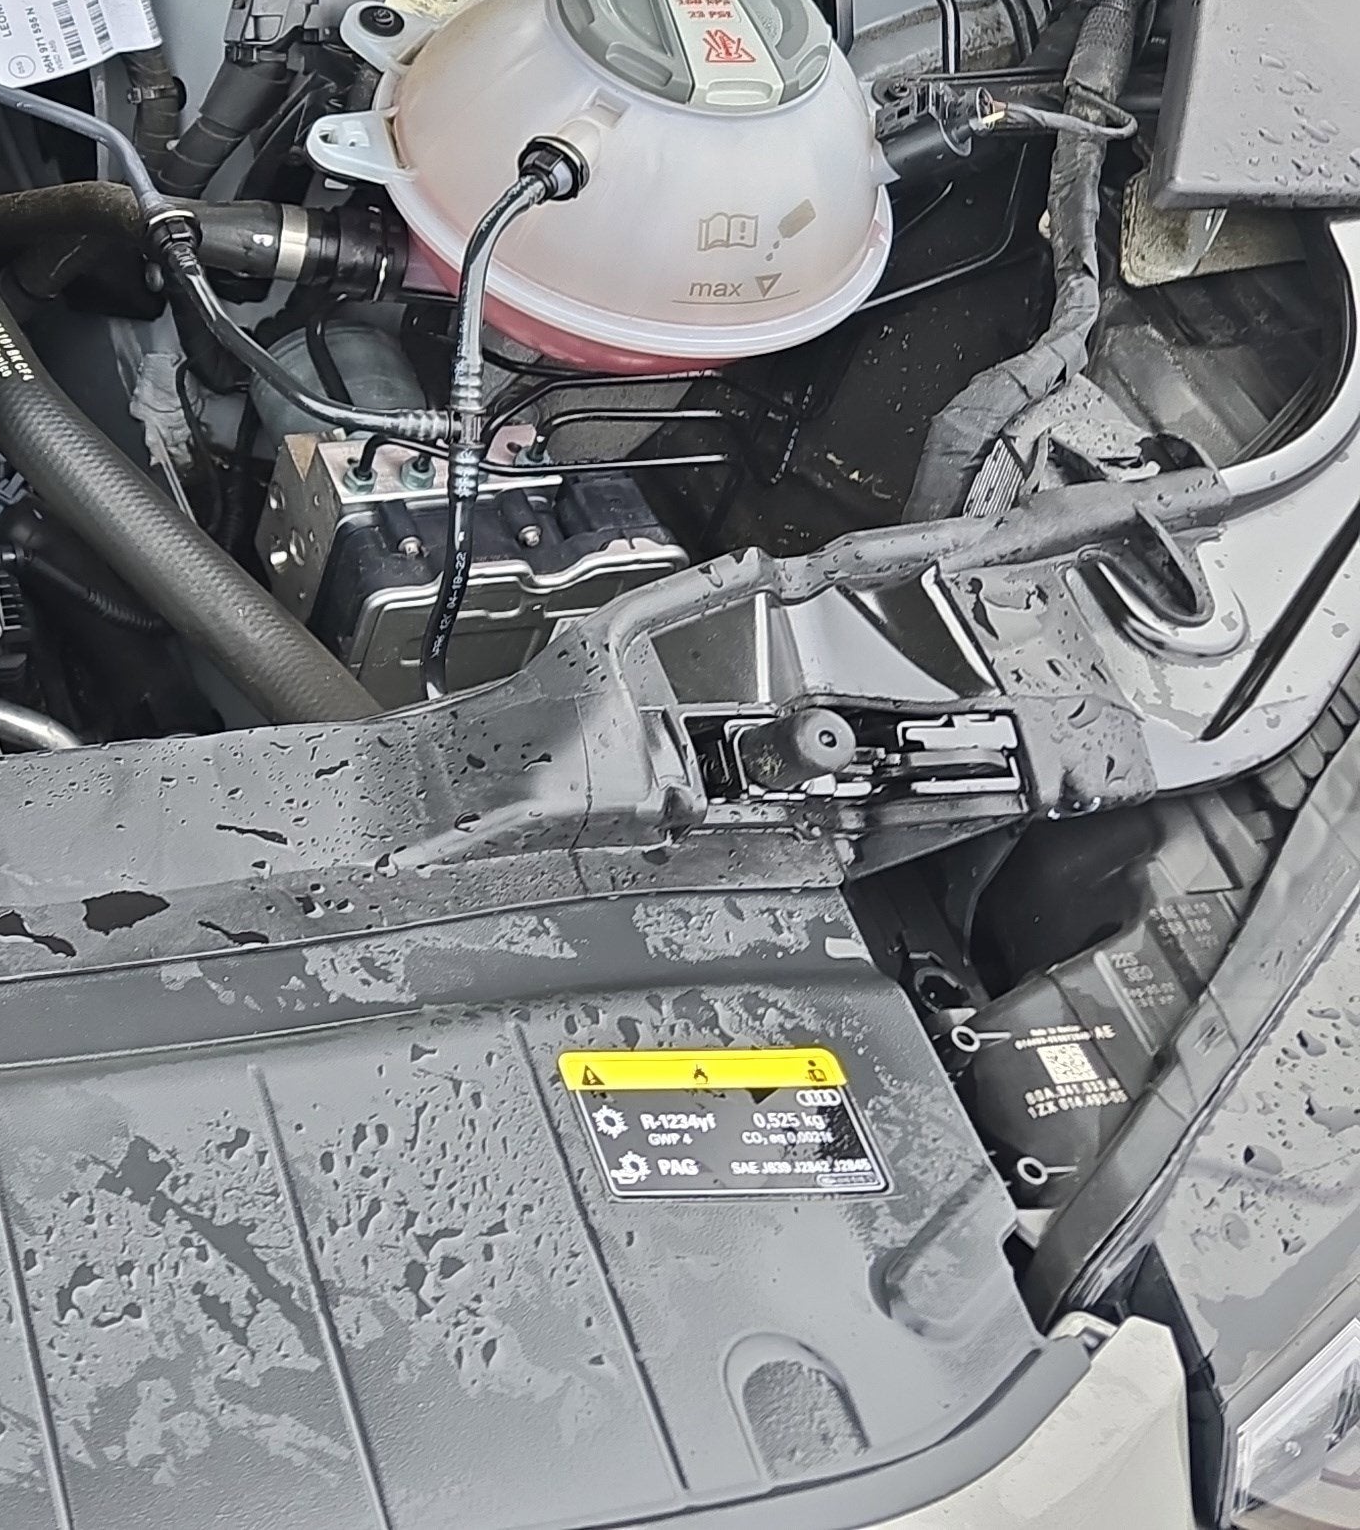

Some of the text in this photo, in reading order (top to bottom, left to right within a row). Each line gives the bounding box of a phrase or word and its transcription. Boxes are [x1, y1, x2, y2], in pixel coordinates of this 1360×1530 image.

[25, 7, 34, 17] N
[29, 17, 42, 37] 595
[35, 37, 49, 56] 971
[689, 279, 742, 299] max
[640, 1114, 717, 1133] R-1234yf
[752, 1112, 826, 1130] 0,525 kg
[648, 1134, 693, 1146] GWP 4
[658, 1159, 700, 1176] PAG
[731, 1162, 760, 1174] SAE
[762, 1162, 792, 1174] J639
